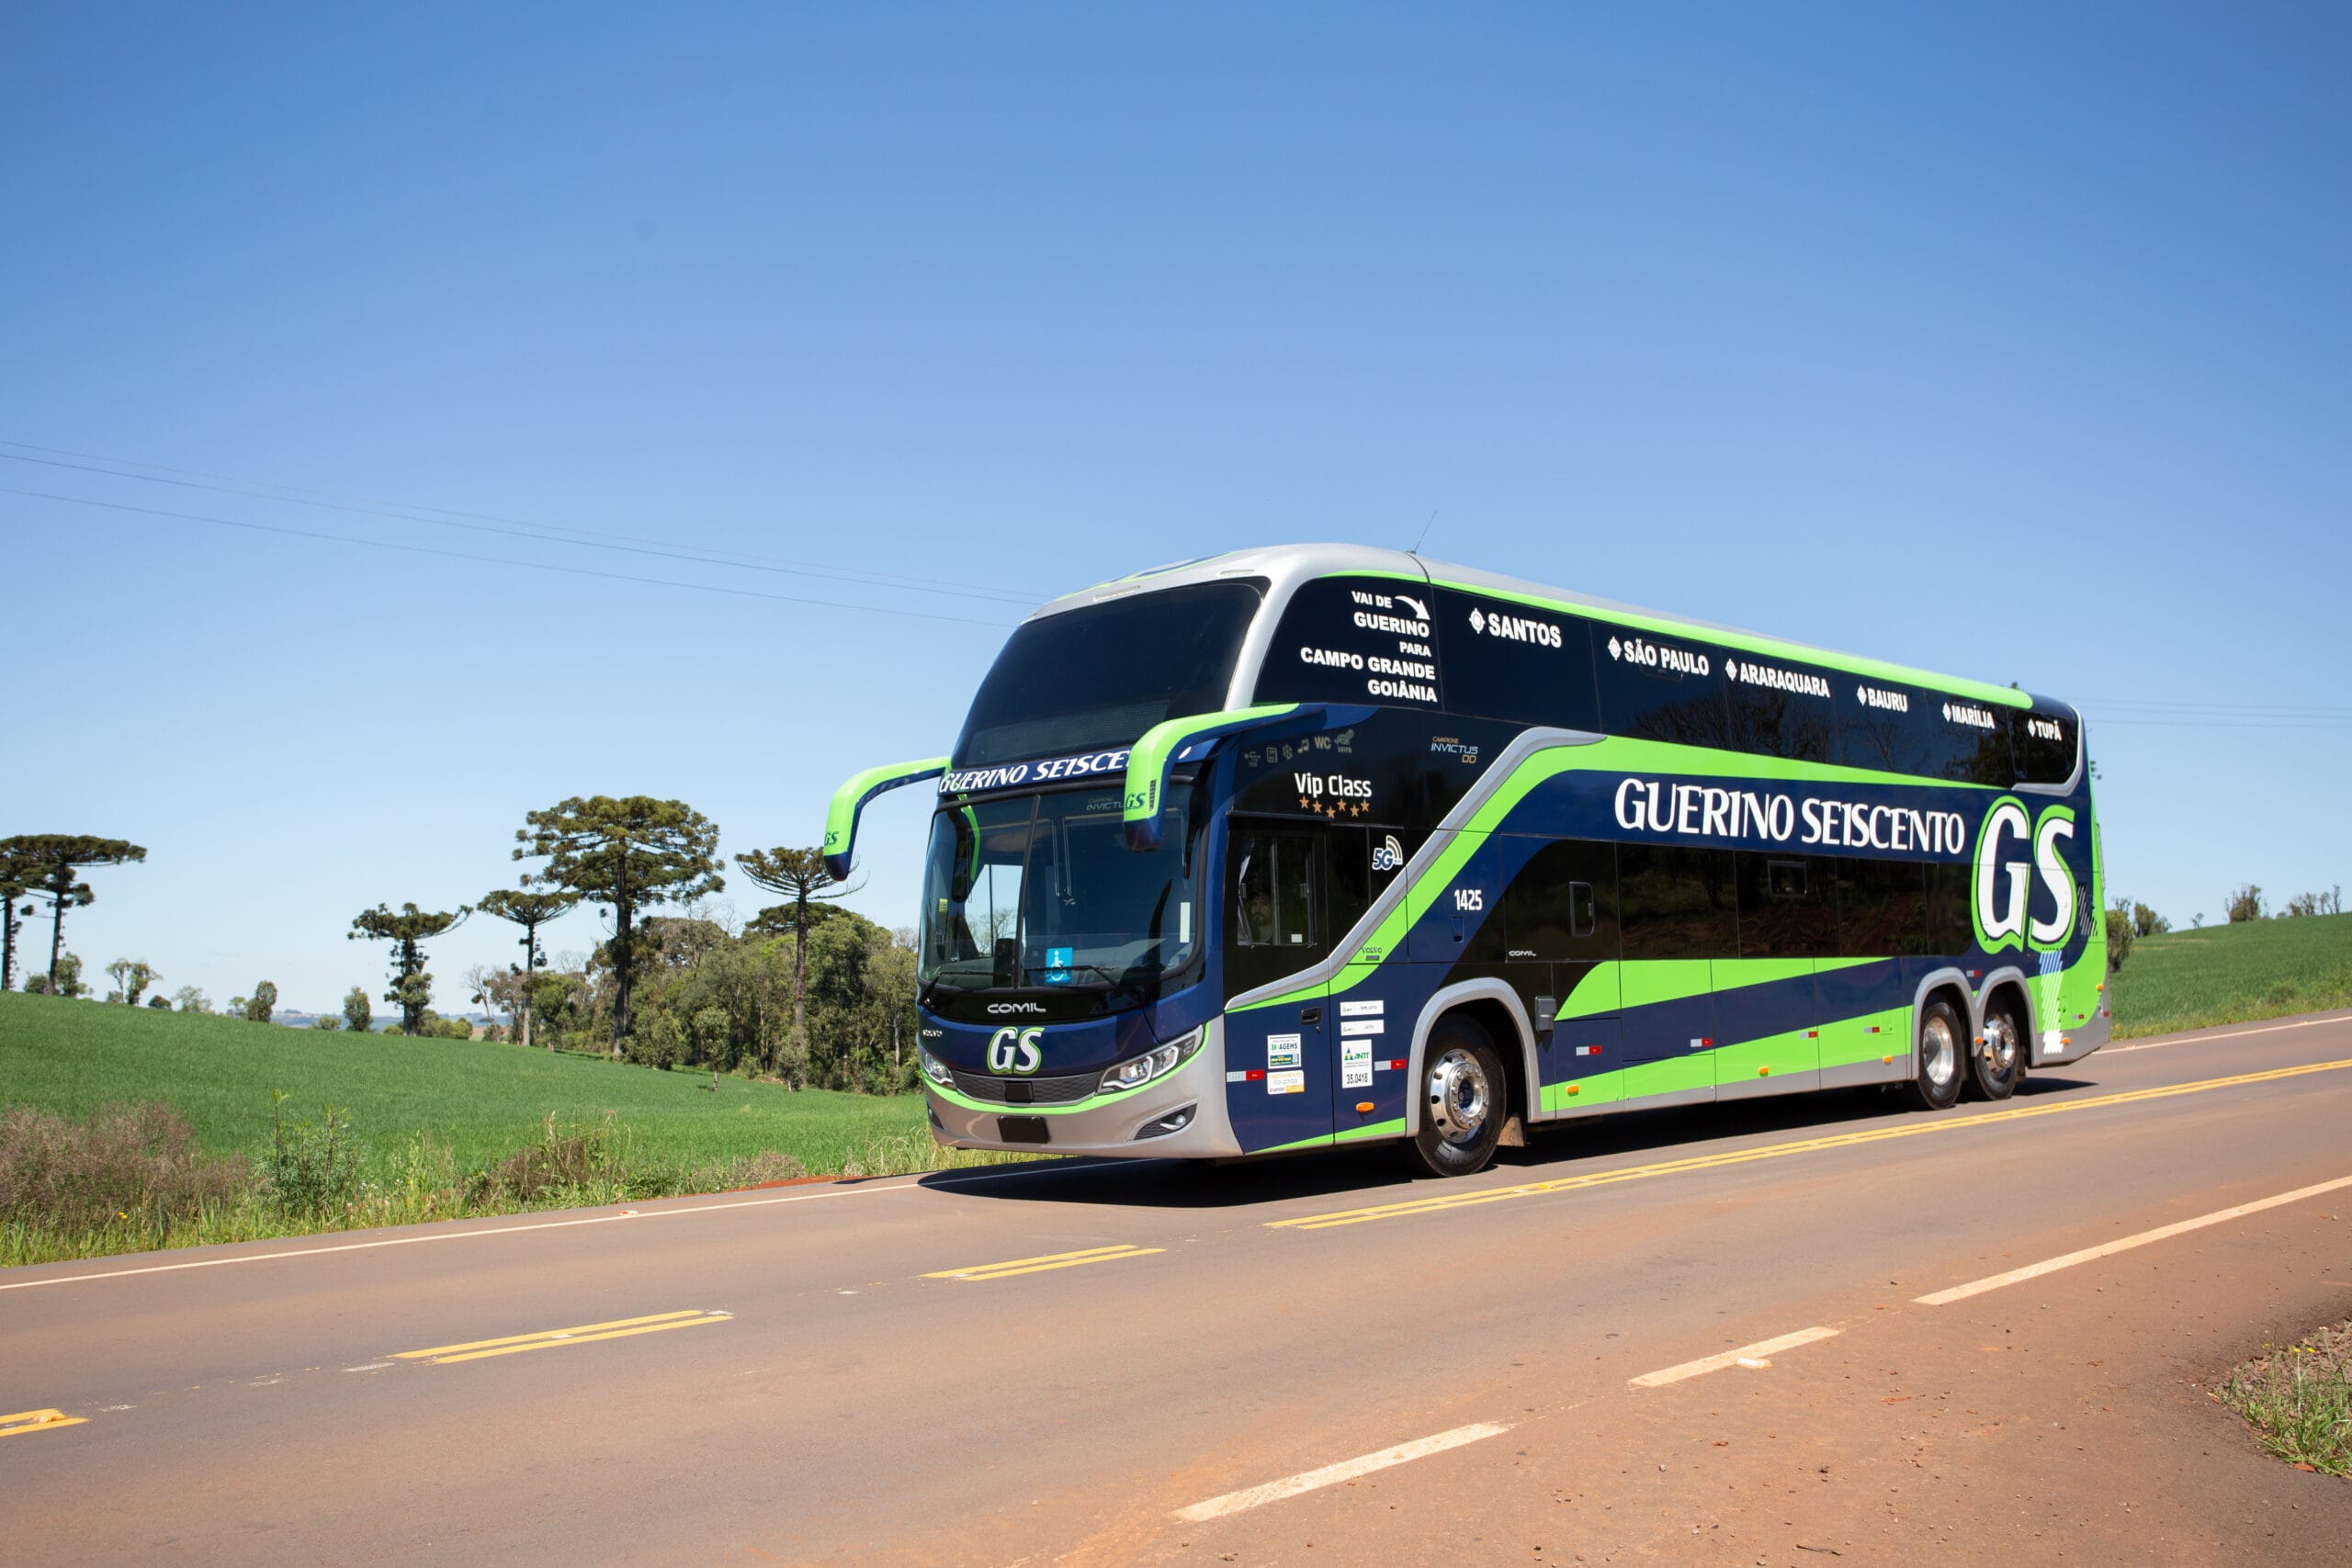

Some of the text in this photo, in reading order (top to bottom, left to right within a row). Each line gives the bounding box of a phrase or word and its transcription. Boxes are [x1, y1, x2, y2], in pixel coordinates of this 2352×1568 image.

[1351, 591, 1392, 608] VAI DE
[1353, 611, 1430, 637] GUERINO
[1487, 613, 1562, 648] SANTOS
[1399, 641, 1431, 657] PARA
[1623, 638, 1710, 676] SÃO PAULO
[1300, 647, 1435, 680] CAMPO GRANDE
[1368, 680, 1437, 703] GOIÂNIA
[1739, 662, 1831, 698] ARARAQUARA
[1867, 687, 1908, 712] BAURU
[1951, 705, 1995, 729] MARÍLIA
[1315, 737, 1331, 750] WC
[1430, 742, 1478, 754] INVICTUS
[939, 763, 1027, 794] GUERINO
[1294, 773, 1373, 798] Vip Class
[1125, 793, 1147, 810] GS
[1614, 778, 1965, 854] GUERINO SEISCENTO
[1373, 848, 1394, 870] 5G
[1974, 799, 2075, 949] GS
[1453, 889, 1483, 910] 1425
[987, 1002, 1046, 1014] COMIL
[988, 1027, 1044, 1074] GS
[1279, 1043, 1298, 1051] AGEMS
[1354, 1052, 1370, 1060] ANTT
[1346, 1073, 1368, 1085] 35.0418
